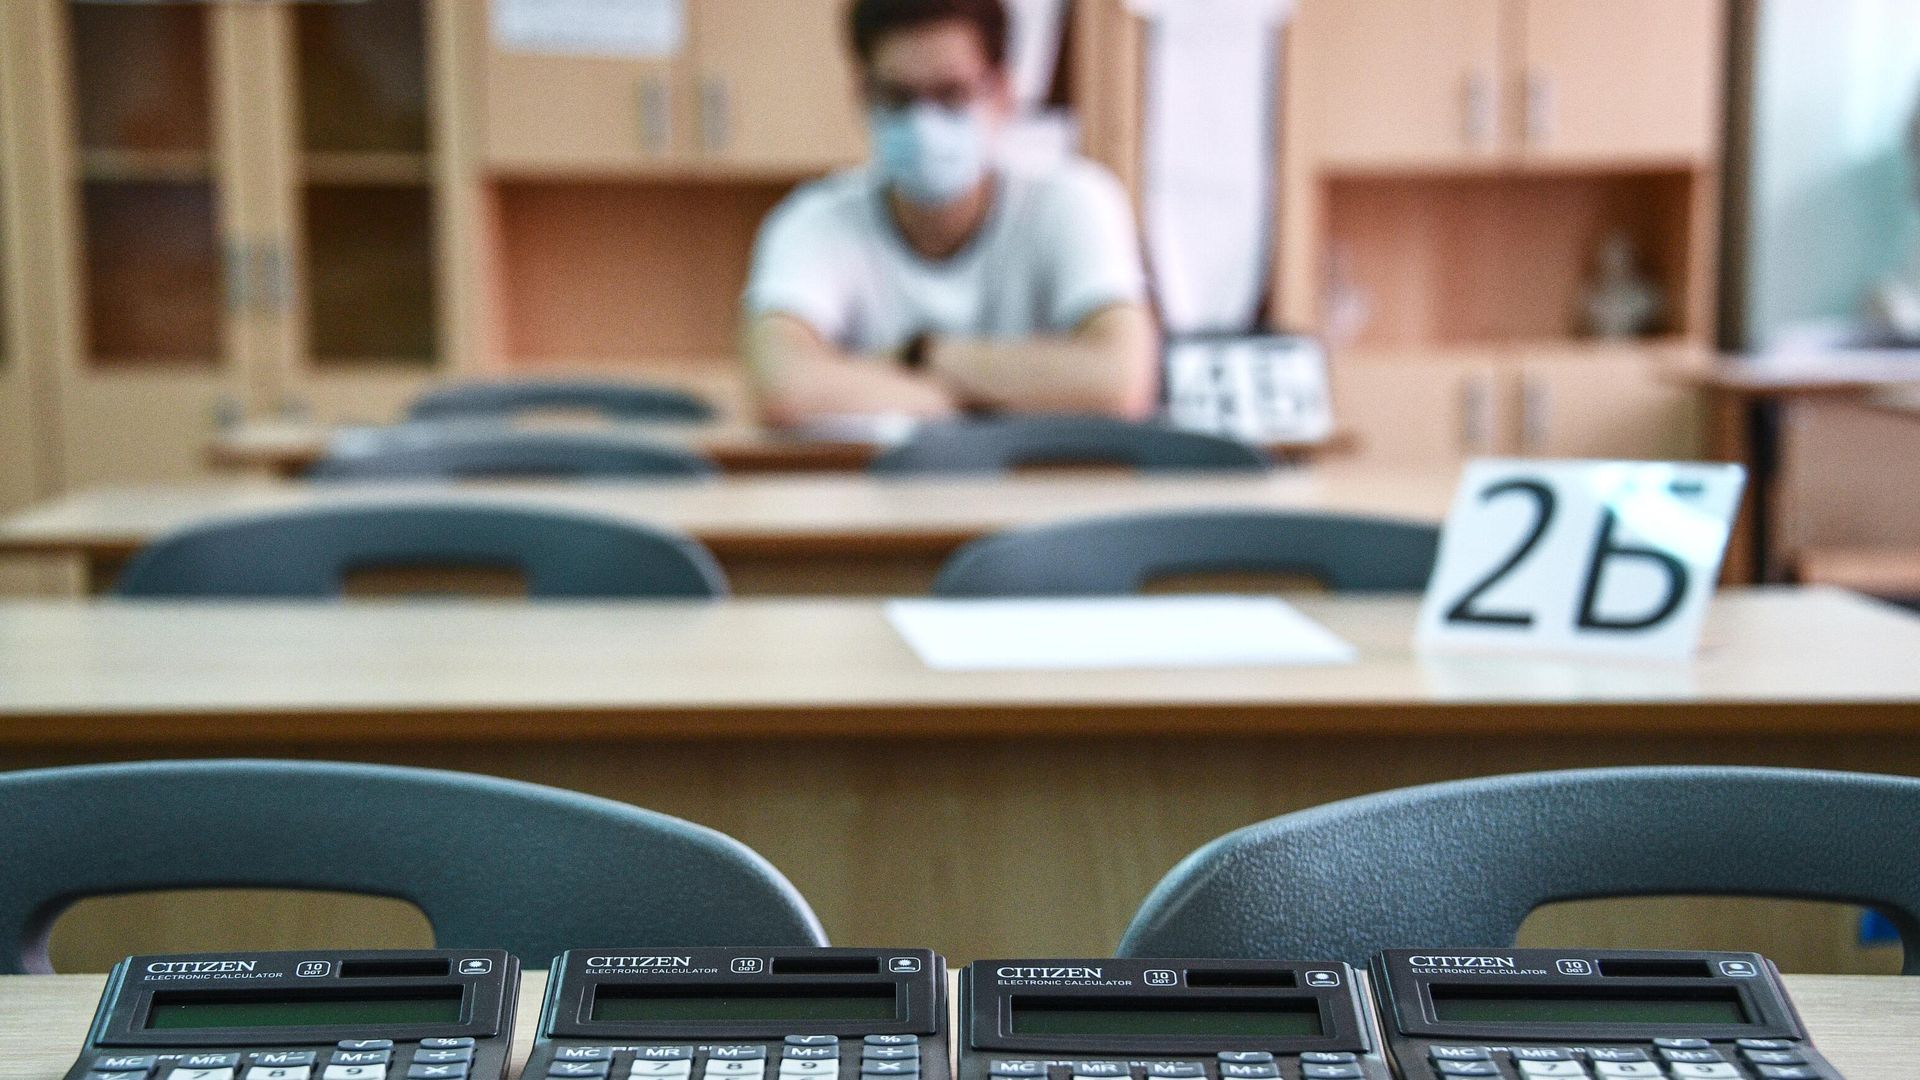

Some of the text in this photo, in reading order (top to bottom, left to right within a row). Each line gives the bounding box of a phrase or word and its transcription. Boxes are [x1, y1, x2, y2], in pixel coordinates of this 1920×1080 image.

[586, 956, 692, 967] CITIZEN
[739, 959, 756, 967] 10
[1408, 955, 1515, 968] CITIZEN
[1564, 961, 1582, 969] 10
[147, 960, 258, 974] CITIZEN
[306, 963, 323, 971] 10
[996, 966, 1102, 979] CITIZEN
[565, 1049, 600, 1057] MC
[645, 1048, 680, 1056] MR
[791, 1047, 830, 1055] M+
[1439, 1048, 1477, 1057] MC
[1520, 1048, 1560, 1057] MR
[188, 1056, 227, 1065] MR
[340, 1053, 381, 1061] M+
[105, 1057, 145, 1066] MC
[653, 1063, 670, 1071] 7
[800, 1062, 818, 1070] 9
[1000, 1063, 1035, 1071] MC
[1081, 1063, 1118, 1072] MR
